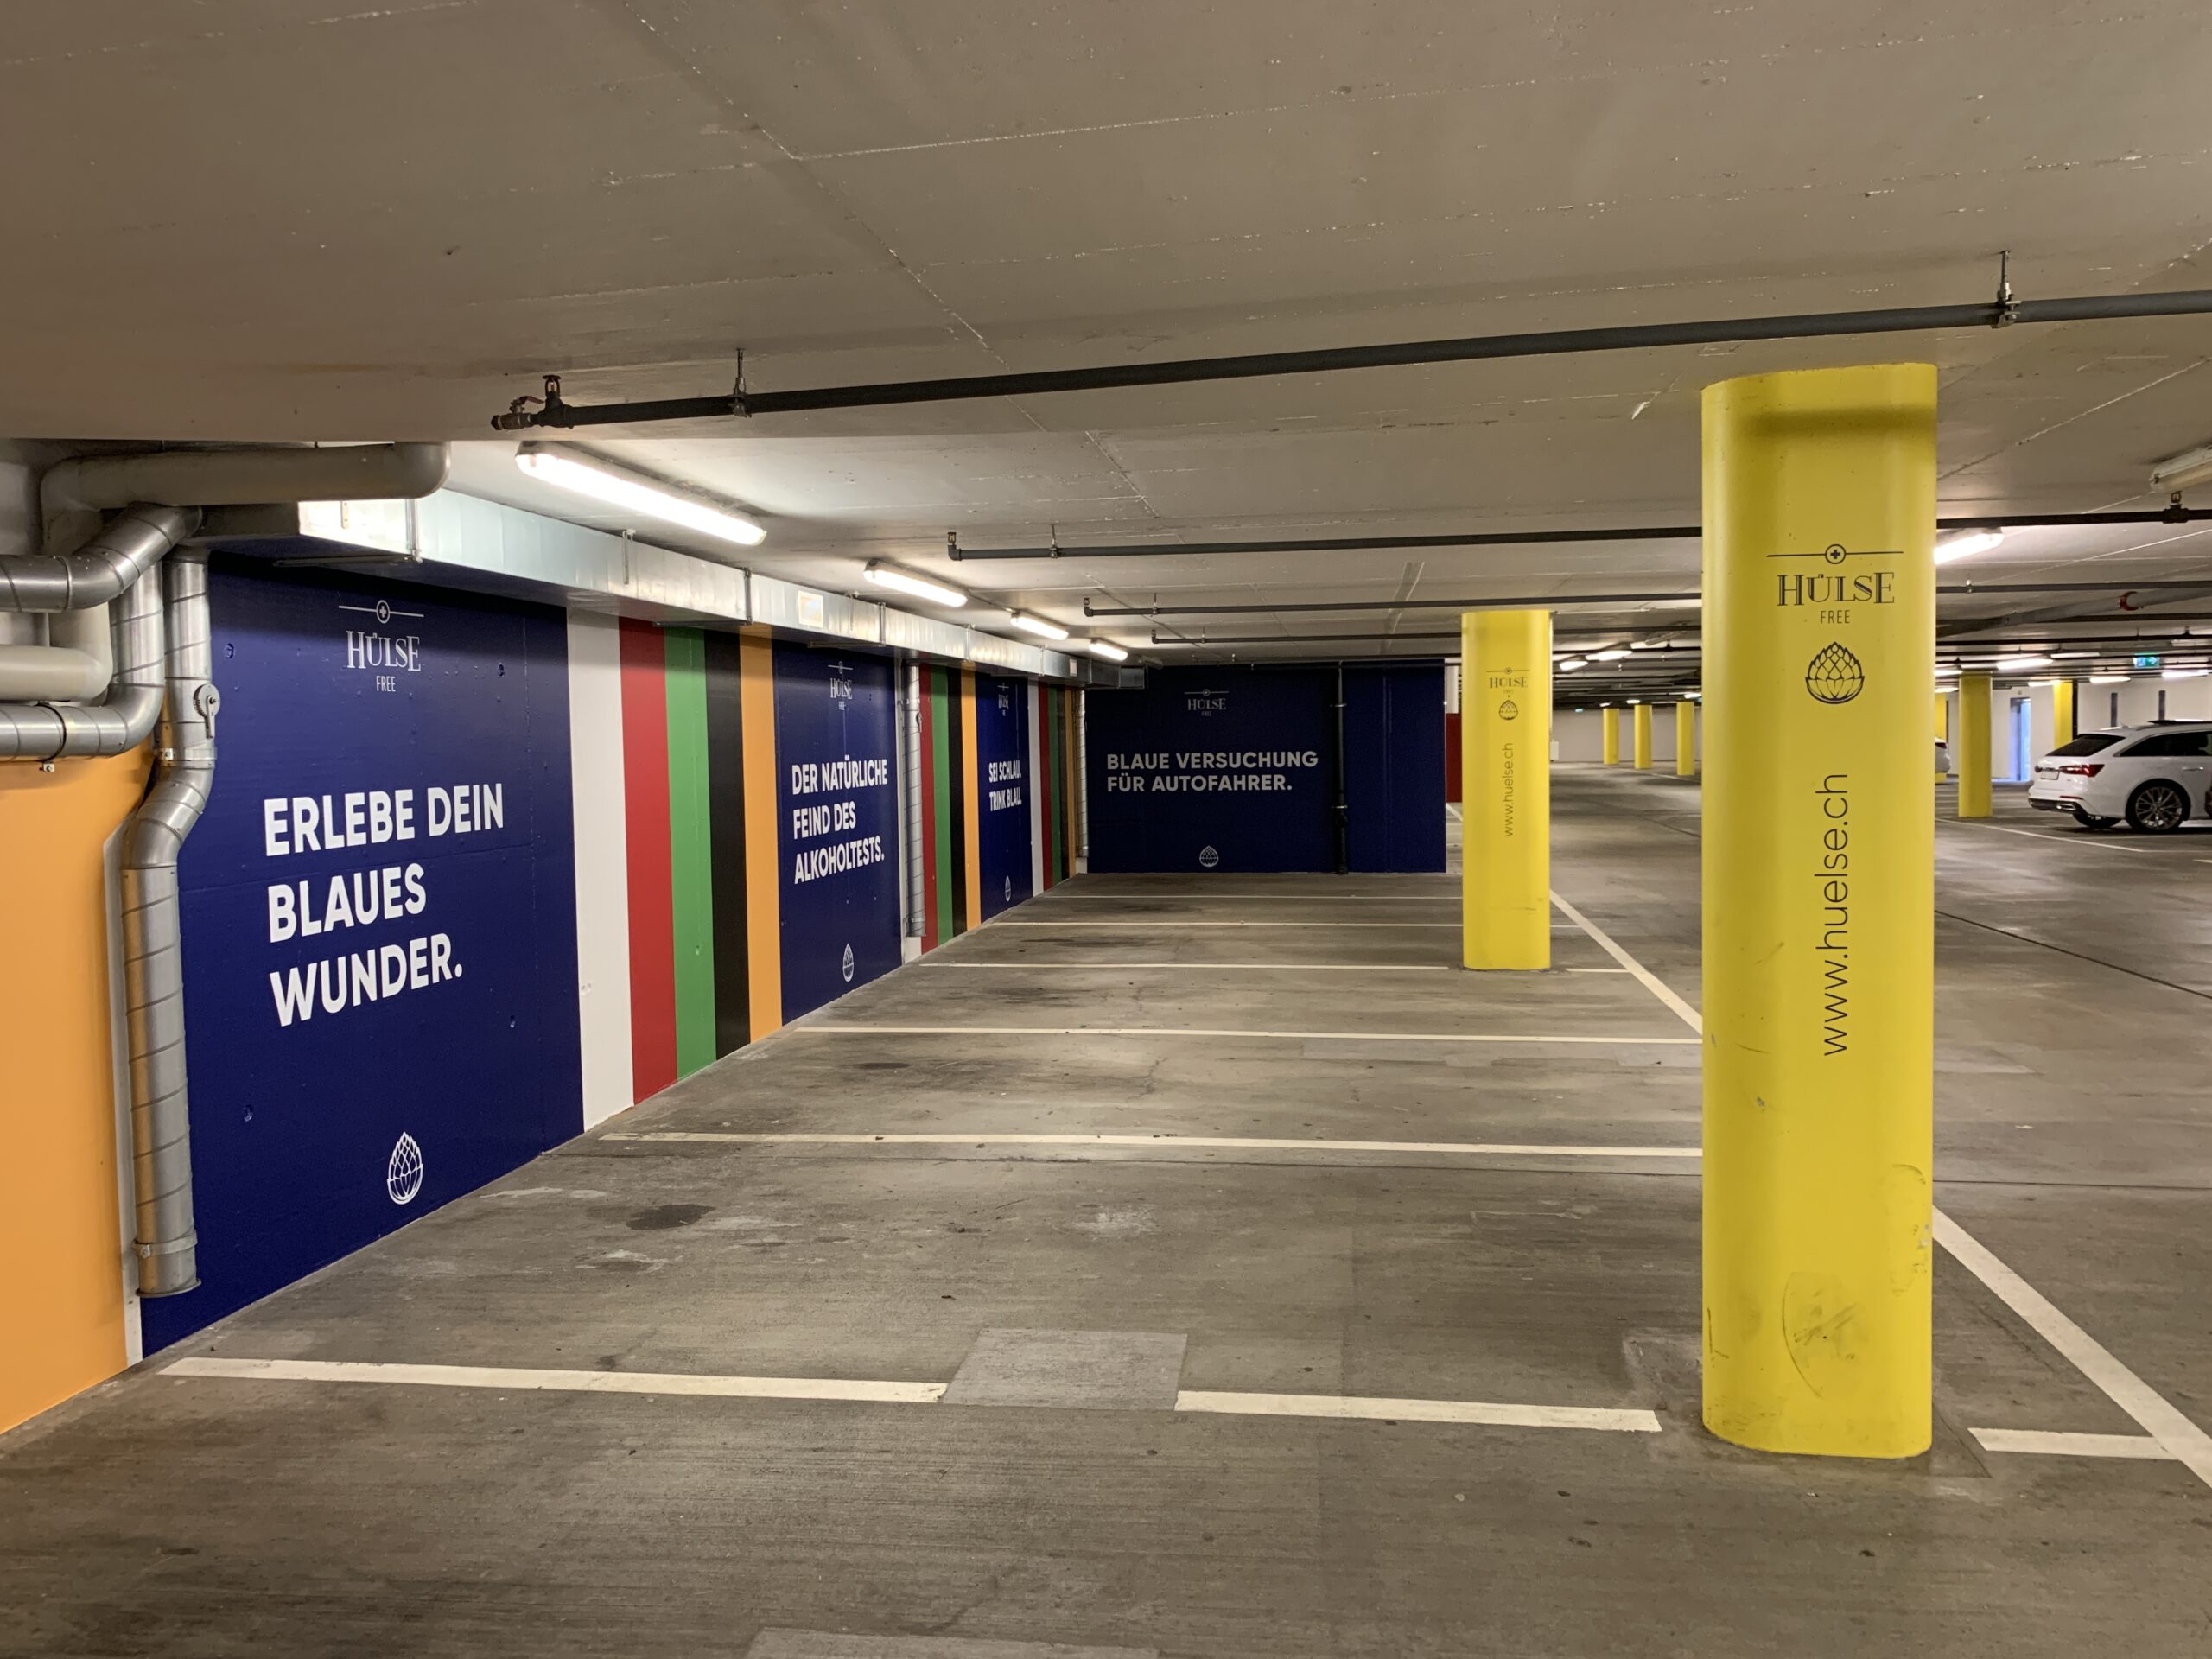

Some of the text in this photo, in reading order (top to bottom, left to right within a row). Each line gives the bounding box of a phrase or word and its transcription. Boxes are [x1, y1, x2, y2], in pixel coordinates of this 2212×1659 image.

[1820, 609, 1851, 624] FREE
[376, 675, 397, 692] FREE
[791, 754, 888, 796] DER NATÜRLICHE
[988, 762, 998, 783] SEI
[1107, 751, 1319, 770] BLAUE VERSUCHUNG
[989, 789, 1007, 812] TRINK
[1107, 772, 1293, 792] FÜR AUTOFAHRER.
[1502, 742, 1514, 837] www.huelse.ch
[264, 782, 504, 857] ERLEBE DEIN
[792, 800, 856, 840] FEIND DES
[794, 835, 885, 885] ALKOHOLTESTS.
[267, 862, 427, 944] BLAUES
[1814, 773, 1848, 1056] www.huelse.ch
[269, 932, 463, 1027] WUNDER.
